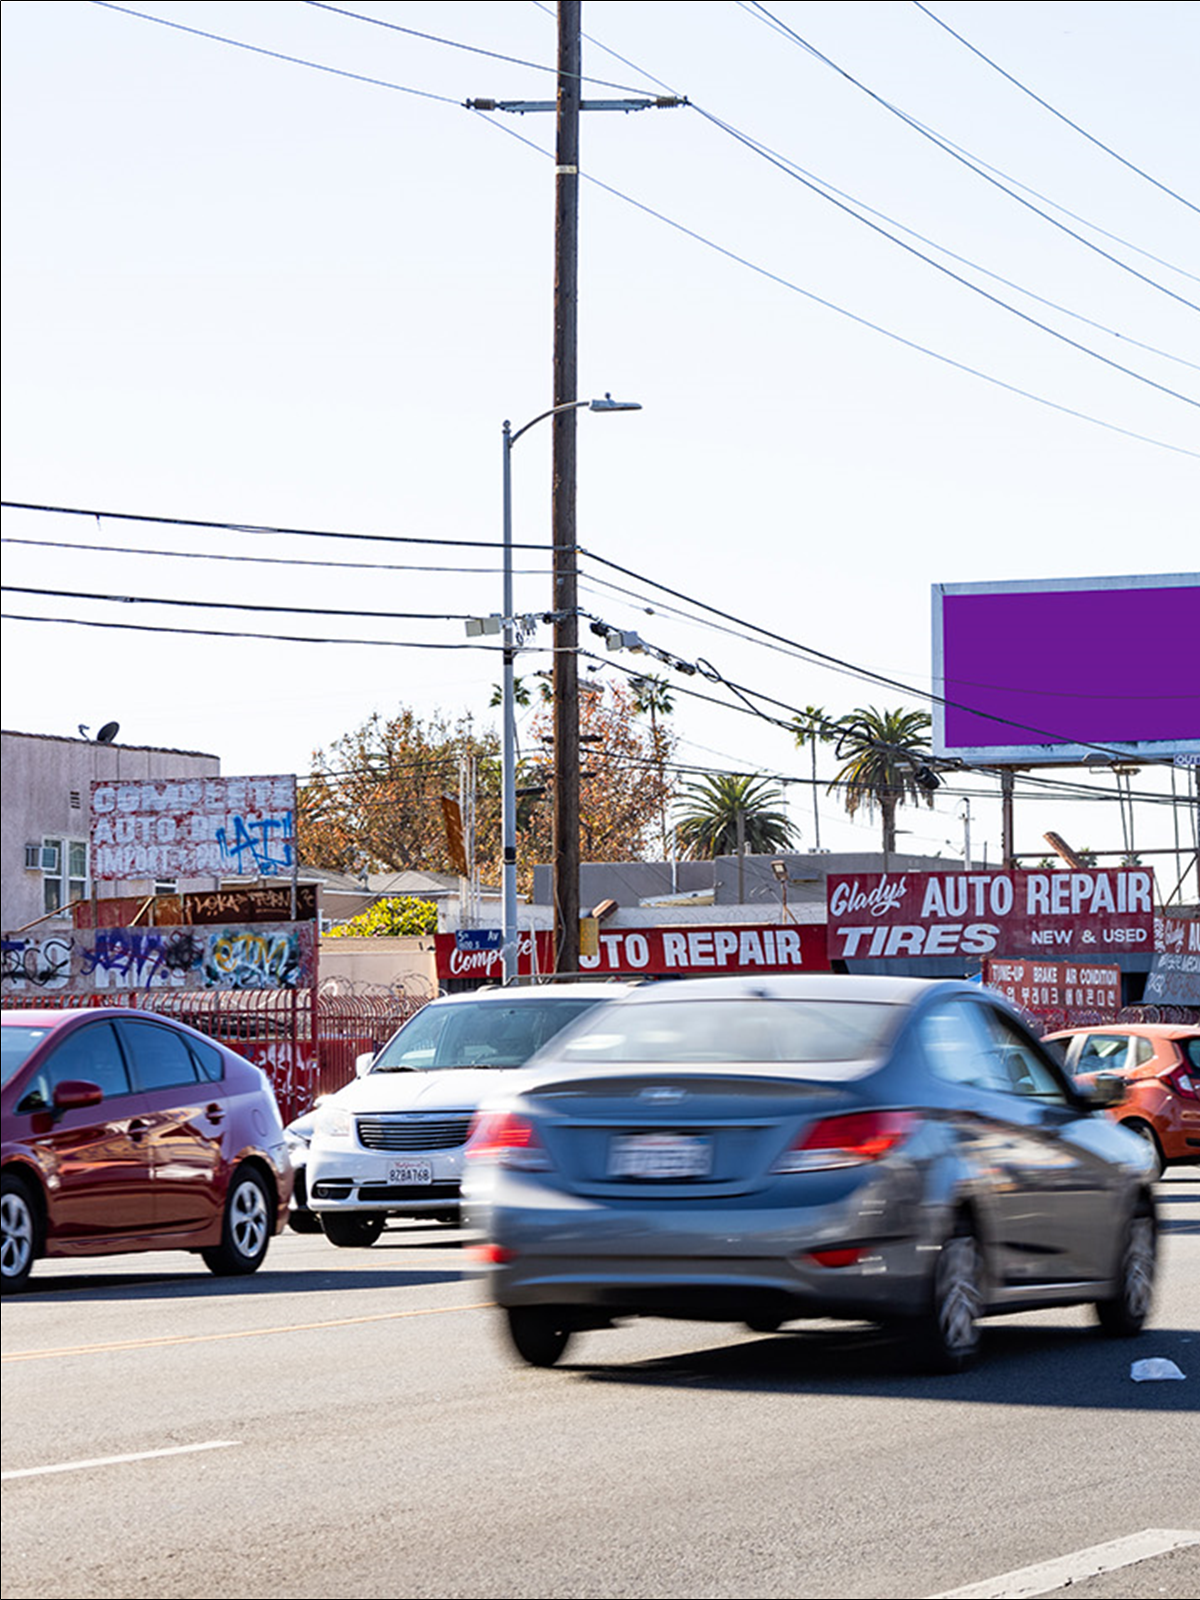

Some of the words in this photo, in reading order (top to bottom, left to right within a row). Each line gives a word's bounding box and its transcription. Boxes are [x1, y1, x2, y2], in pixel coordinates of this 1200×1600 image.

[830, 873, 908, 917] Gladys
[920, 875, 1014, 918] AUTO
[1026, 871, 1151, 915] REPAIR
[662, 929, 802, 967] REPAIR
[836, 923, 1000, 957] TIRES
[1031, 929, 1073, 945] NEW
[1081, 929, 1097, 944] &
[1103, 928, 1147, 943] USED
[992, 964, 1024, 982] TUNE-UP
[1033, 966, 1058, 983] BRAKE
[1065, 967, 1077, 984] AIR
[1079, 968, 1118, 985] CONDITION
